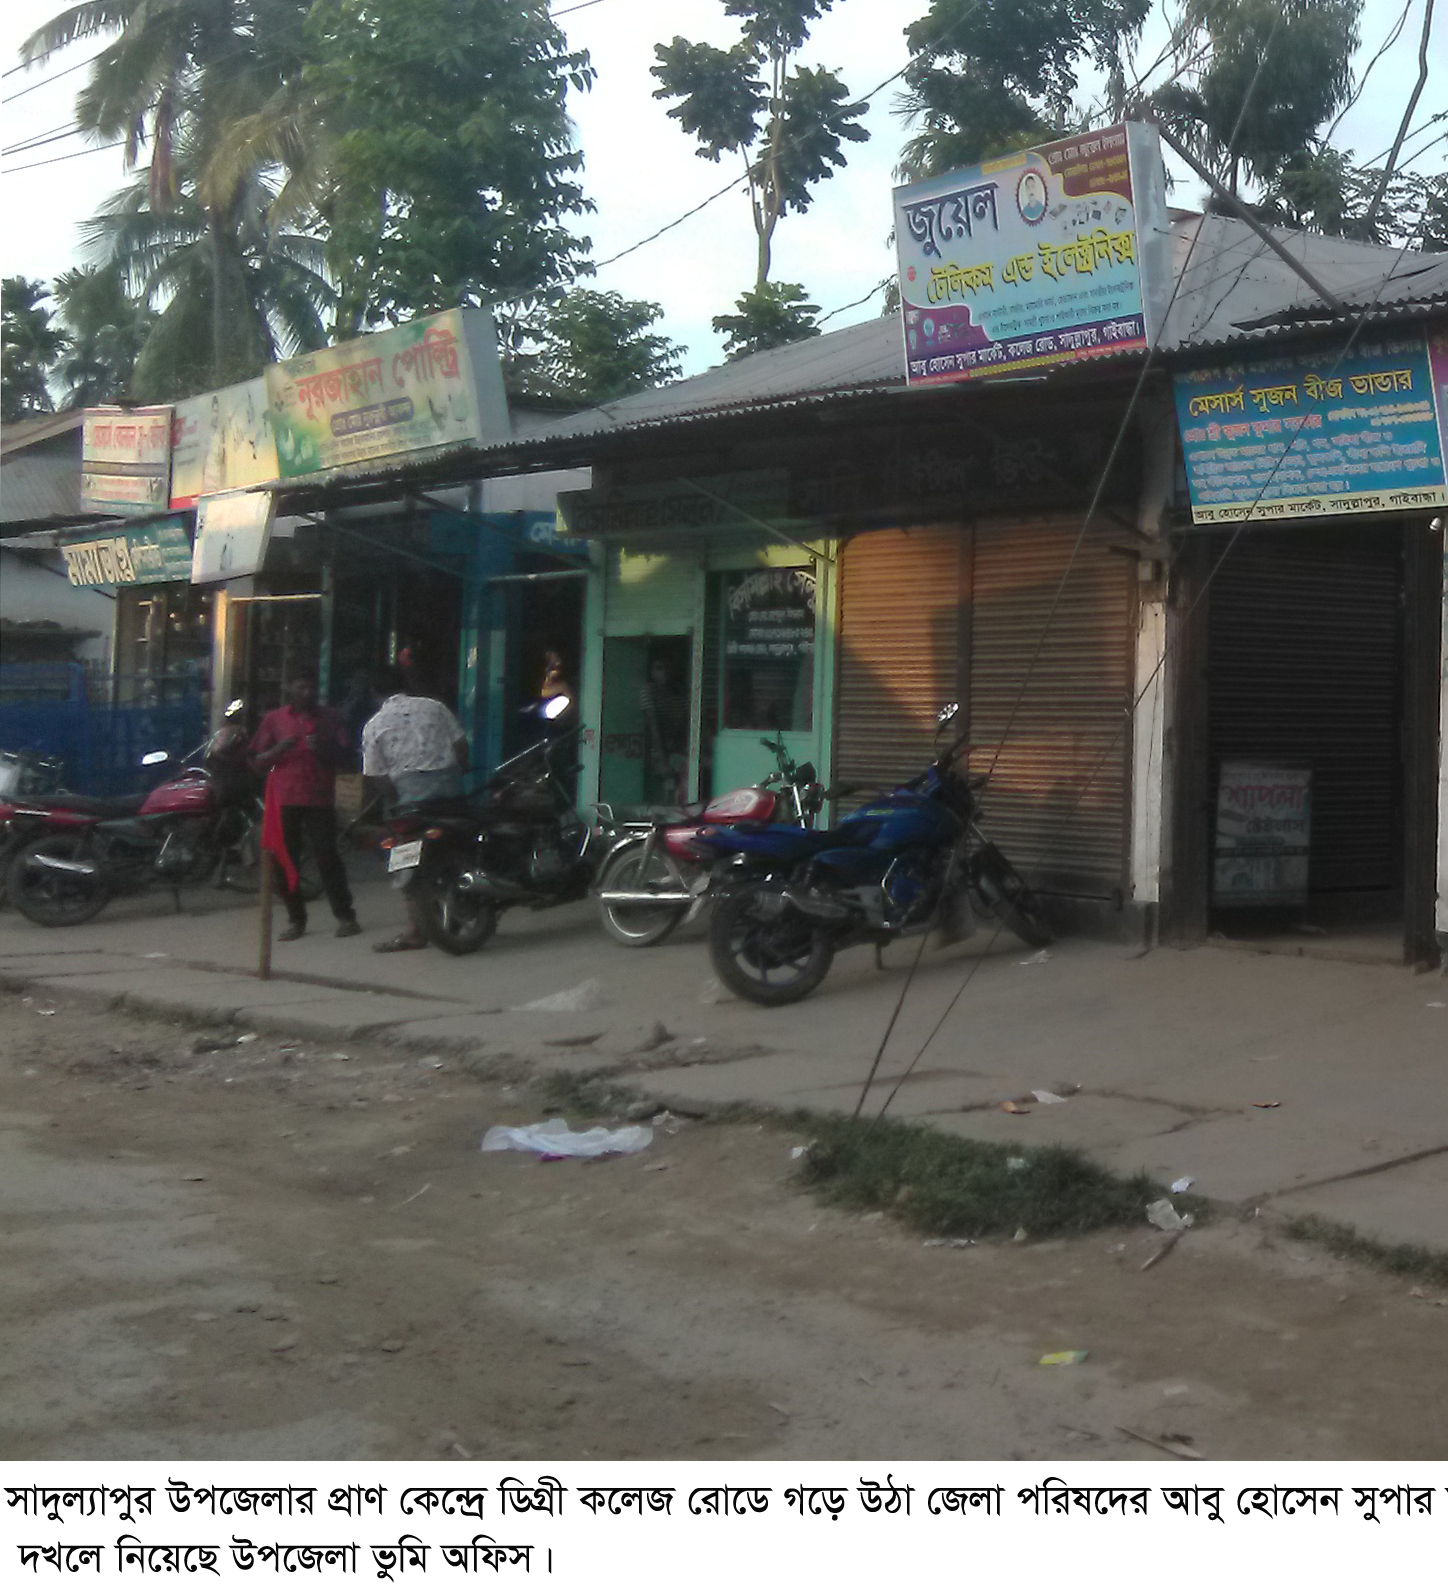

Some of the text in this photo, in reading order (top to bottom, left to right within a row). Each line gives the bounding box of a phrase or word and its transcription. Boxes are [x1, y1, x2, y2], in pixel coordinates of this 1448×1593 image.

[902, 181, 999, 258] জুয়েল
[926, 260, 996, 304] টেলিকম
[1189, 384, 1244, 417] মেসার্স
[1250, 384, 1298, 414] সুজন
[1303, 374, 1344, 401] বীজ
